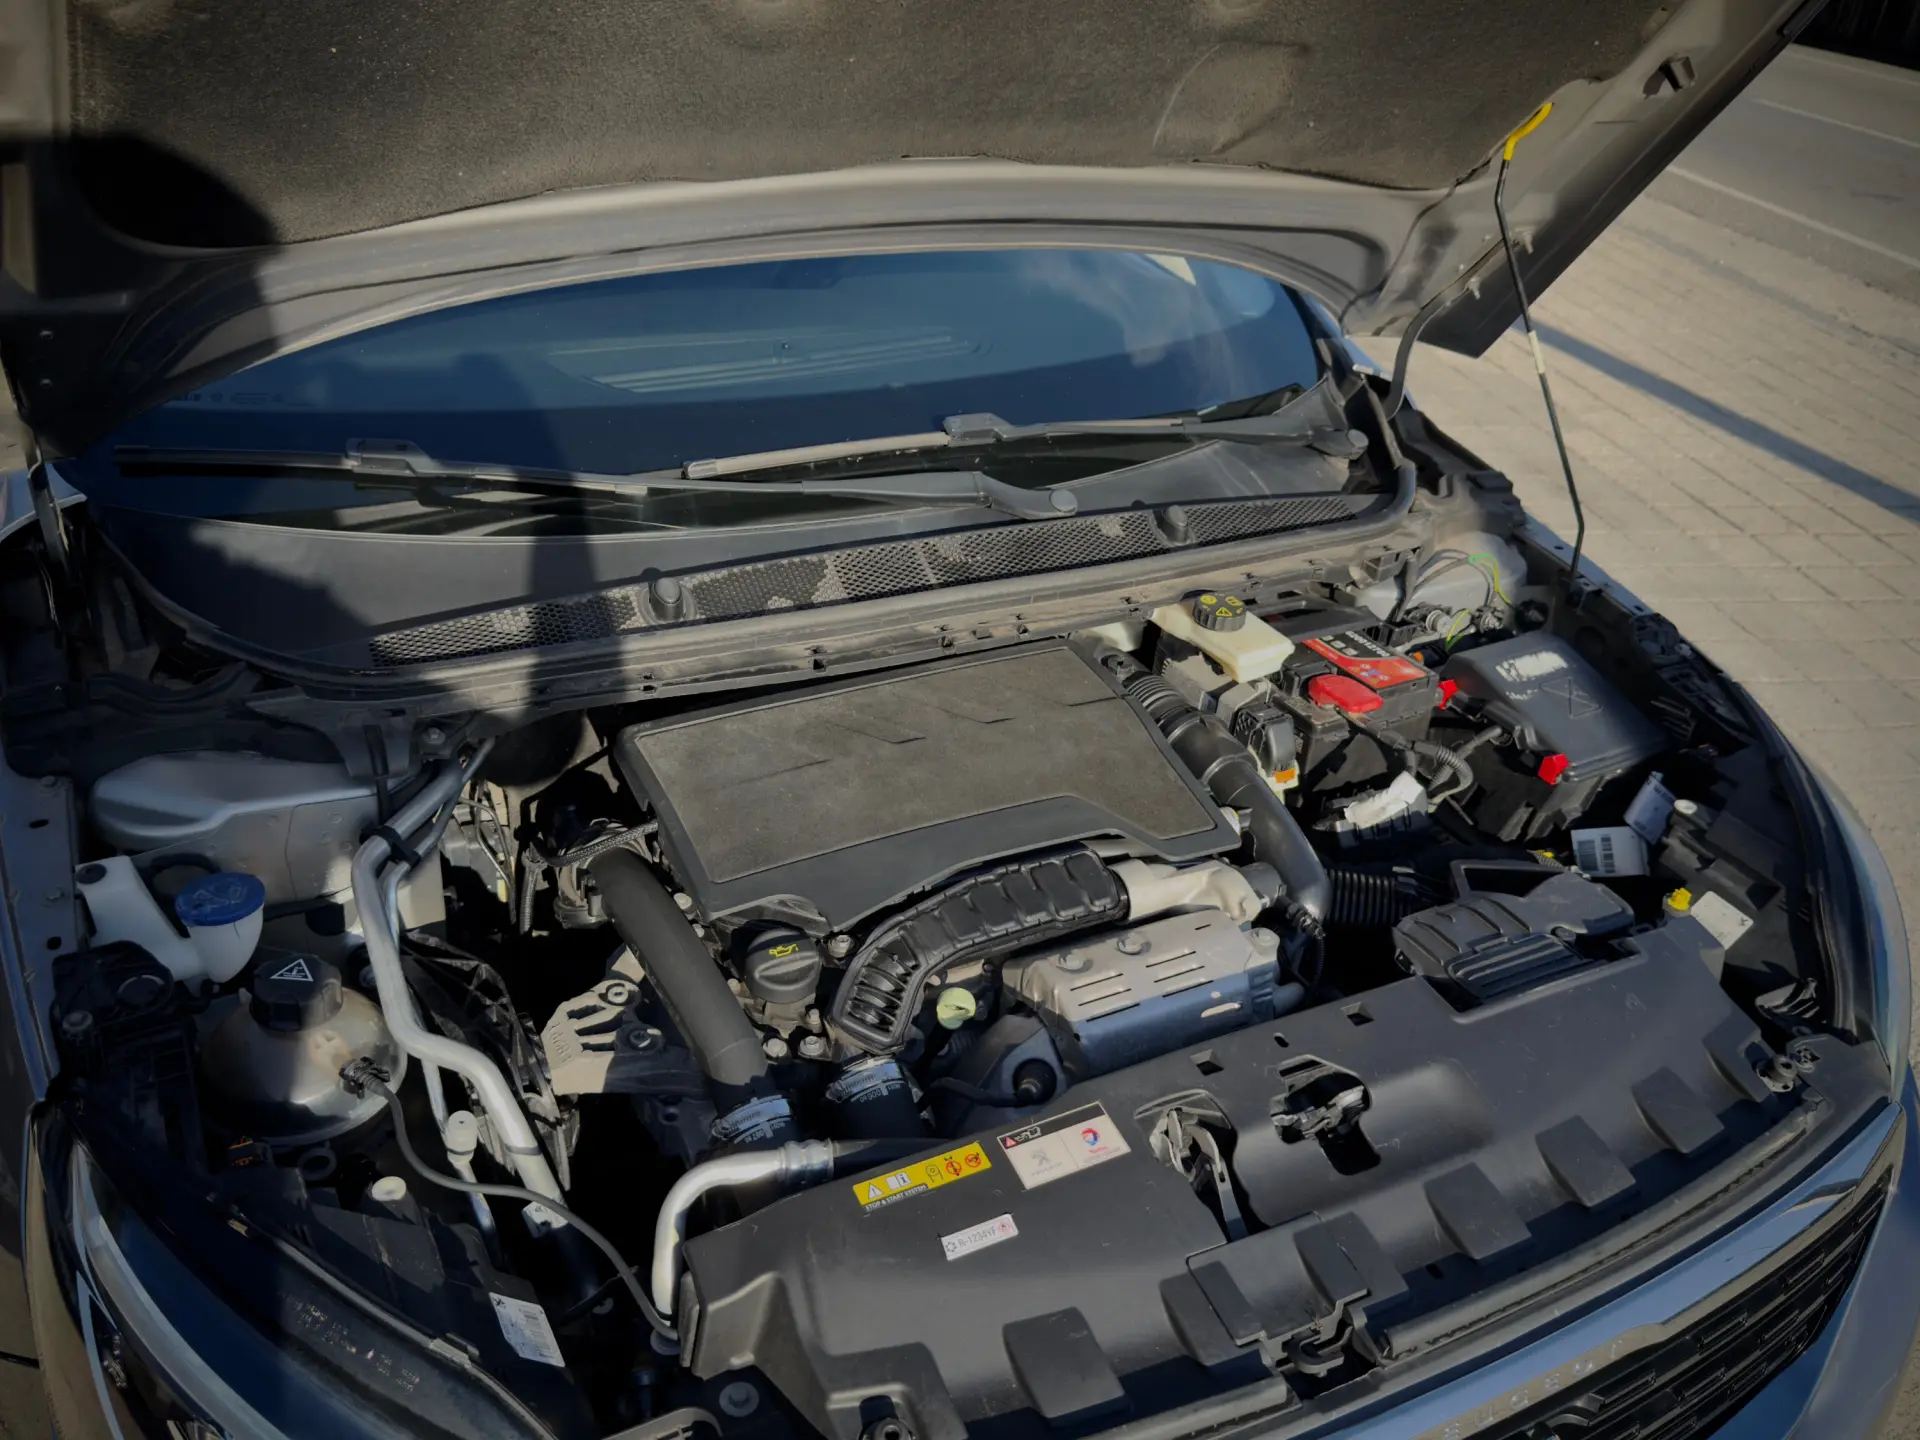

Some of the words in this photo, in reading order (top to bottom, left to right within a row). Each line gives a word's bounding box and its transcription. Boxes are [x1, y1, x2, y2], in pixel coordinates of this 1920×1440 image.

[865, 1200, 881, 1213] STOP
[886, 1192, 906, 1204] START
[905, 1183, 928, 1198] SYSTEM
